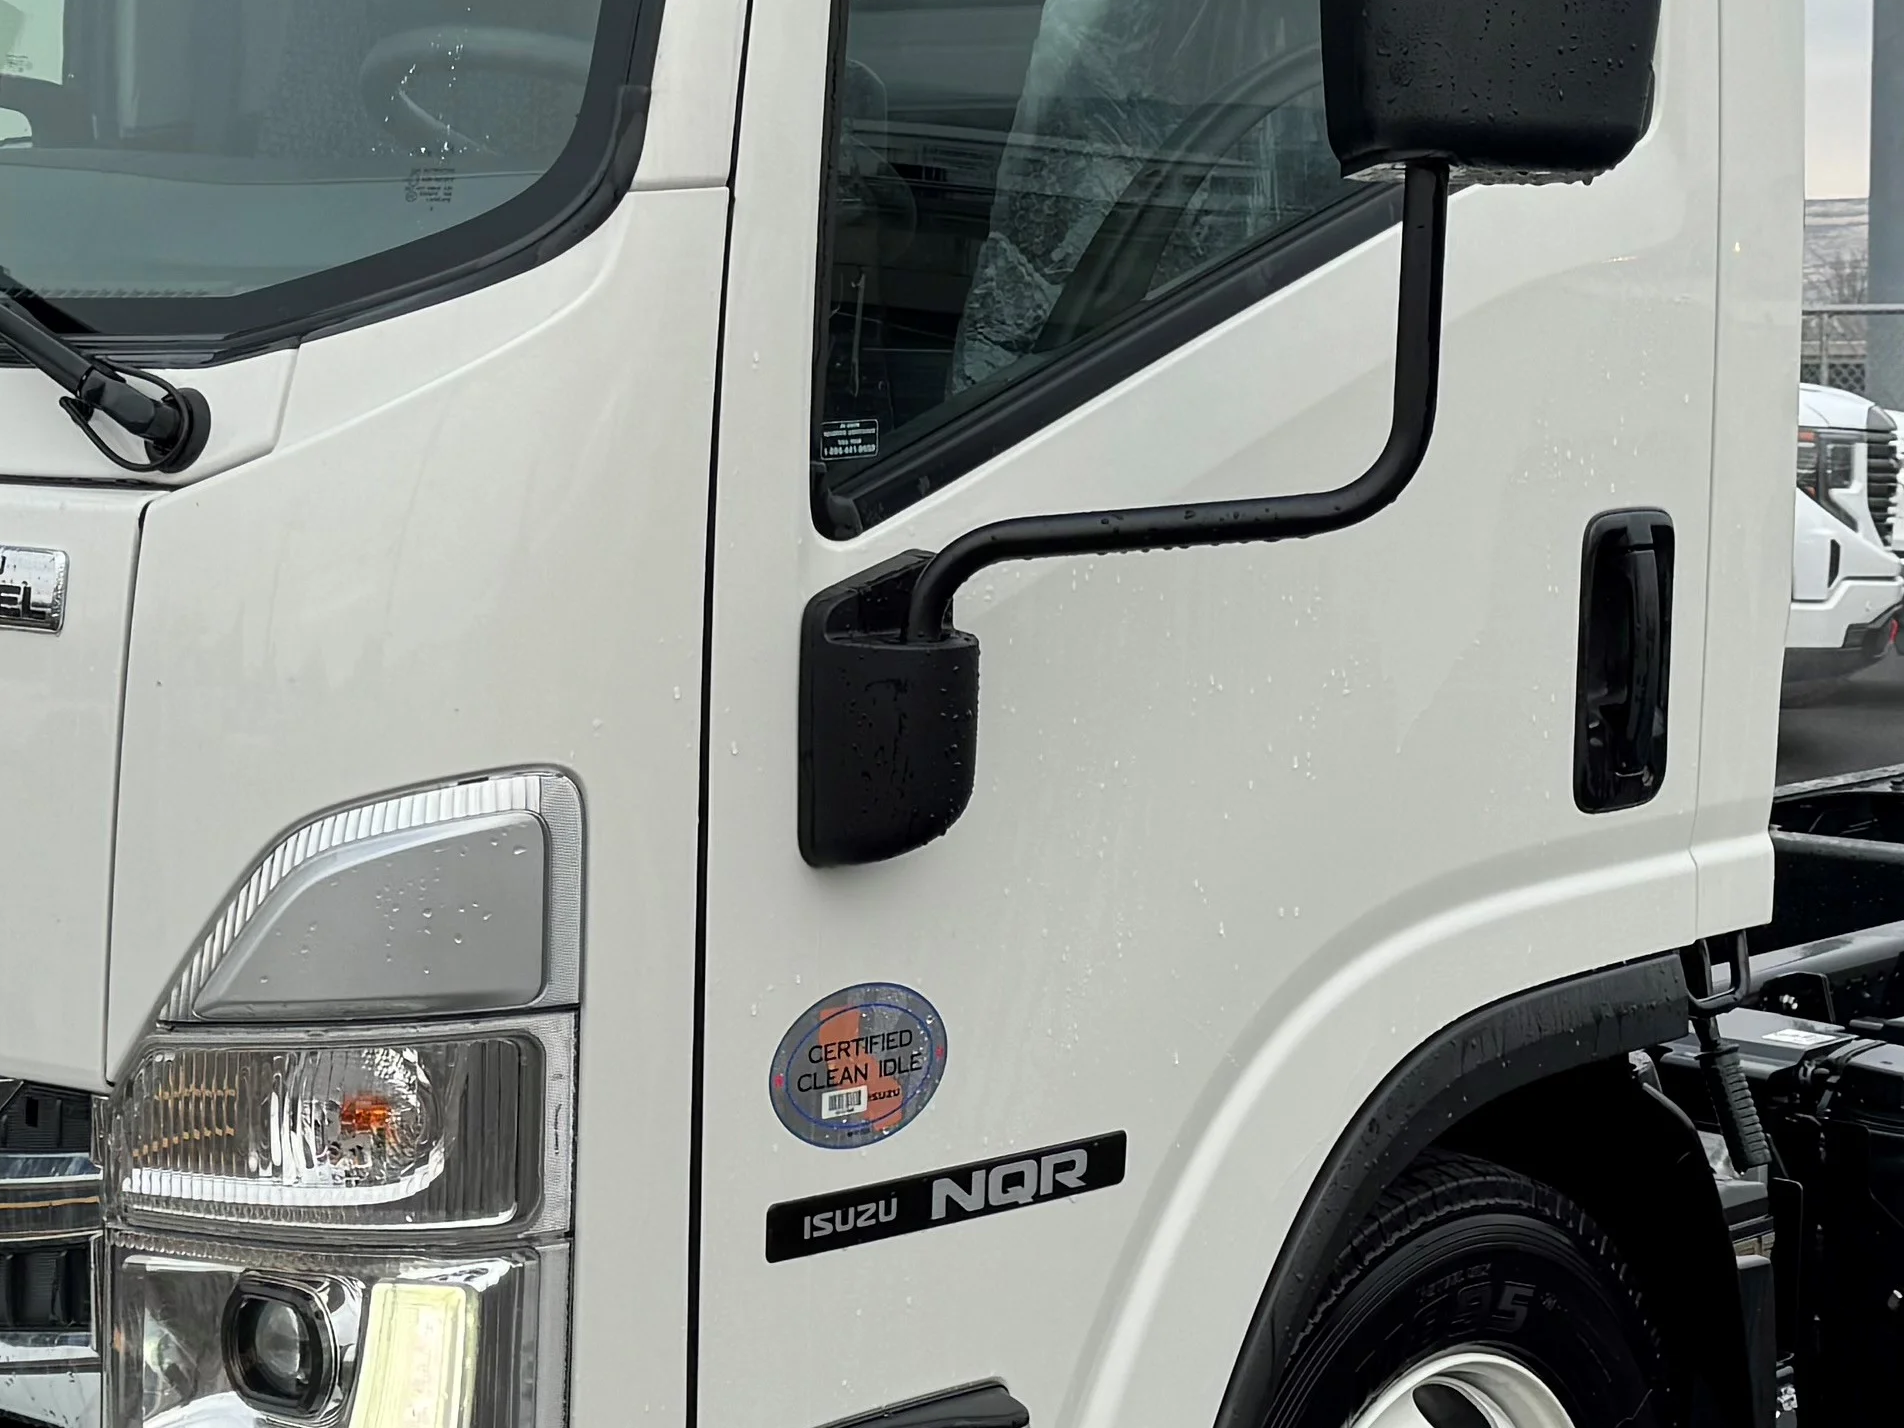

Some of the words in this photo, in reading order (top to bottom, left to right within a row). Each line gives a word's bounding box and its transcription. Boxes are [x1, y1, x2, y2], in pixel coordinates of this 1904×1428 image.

[808, 1028, 913, 1065] CERTIFIED
[797, 1063, 869, 1093] CLEAN
[878, 1053, 923, 1077] IDLE
[803, 1196, 898, 1239] ISUZU
[930, 1148, 1088, 1221] NQR
